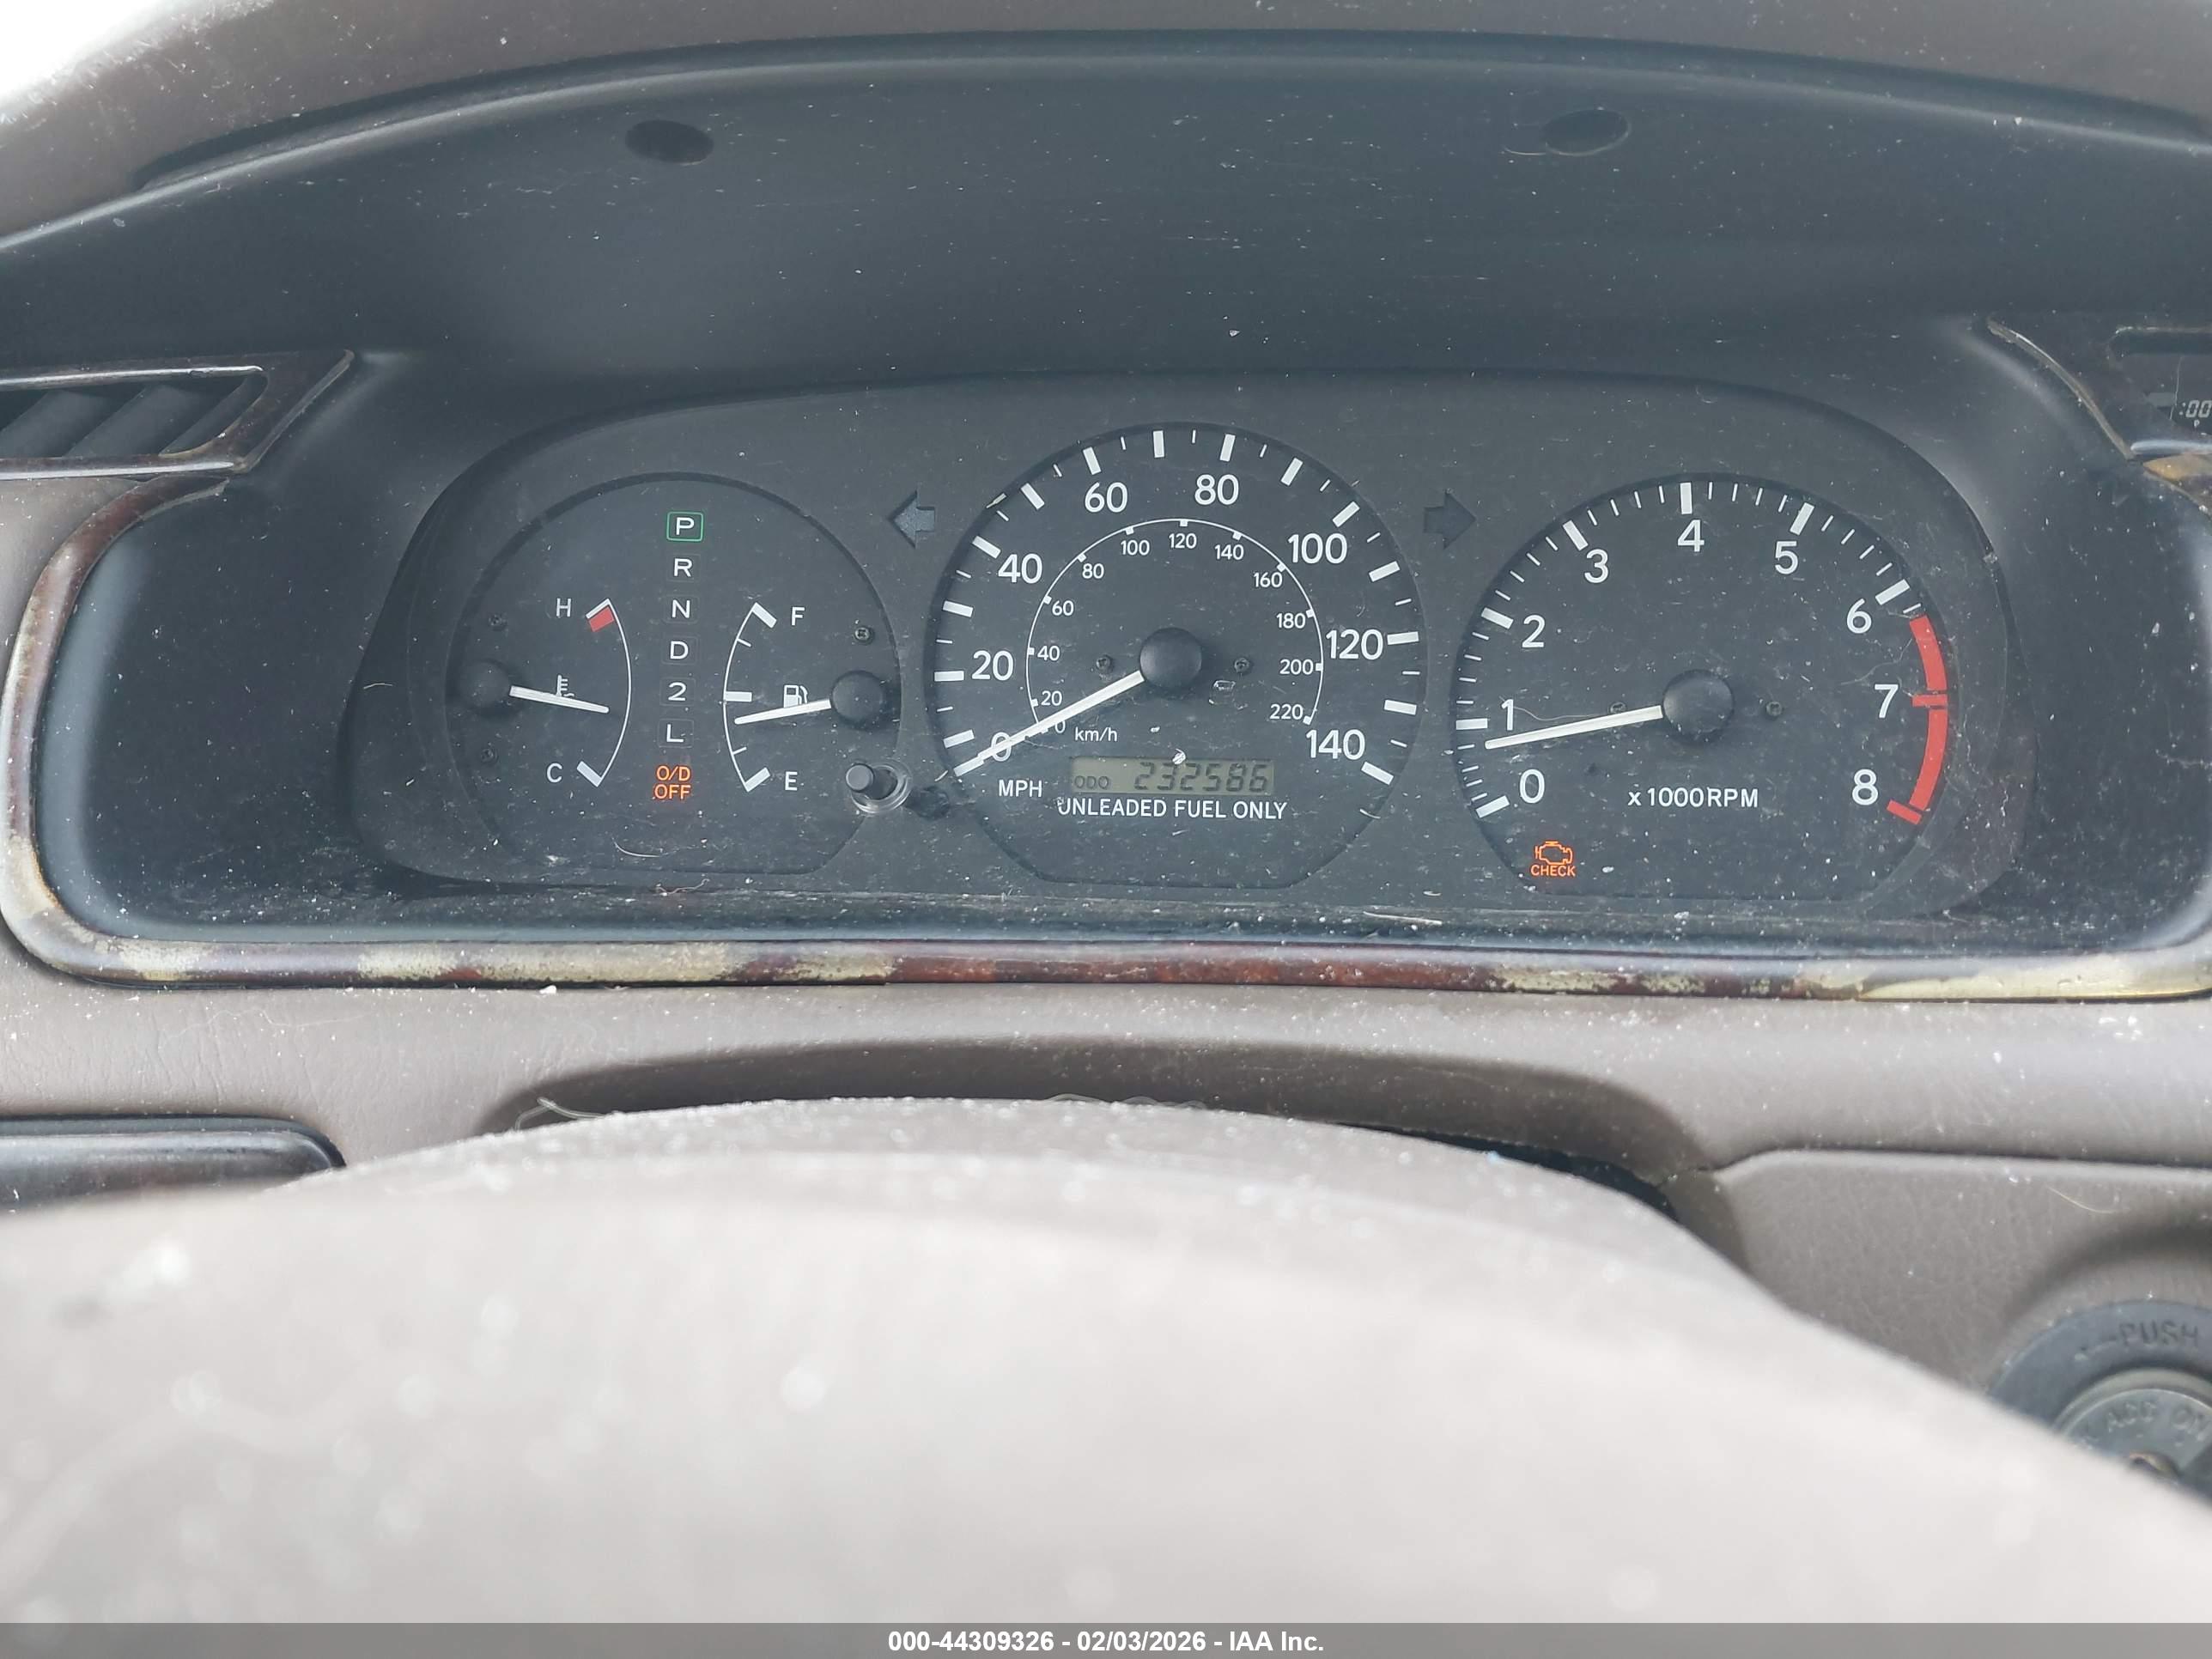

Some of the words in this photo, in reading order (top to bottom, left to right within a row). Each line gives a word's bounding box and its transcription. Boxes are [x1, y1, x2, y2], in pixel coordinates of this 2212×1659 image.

[1085, 482, 1128, 513] 60
[1194, 474, 1239, 506] 80
[676, 517, 695, 536] P
[1677, 519, 1705, 552] 4
[1121, 539, 1150, 556] 100
[1169, 532, 1197, 550] 120
[1287, 532, 1348, 564] 100
[1214, 544, 1244, 561] 140
[1774, 540, 1799, 574] 5
[673, 558, 693, 577] R
[998, 553, 1042, 584] 40
[1082, 562, 1105, 580] 80
[1584, 549, 1609, 584] 3
[1254, 571, 1283, 588] 160
[556, 598, 572, 617] H
[672, 599, 690, 618] N
[791, 606, 805, 626] F
[1052, 599, 1074, 617] 60
[1846, 598, 1872, 634] 6
[1276, 612, 1306, 629] 180
[1522, 614, 1546, 648] 2
[670, 641, 689, 659] D
[1036, 645, 1060, 661] 40
[1326, 629, 1383, 660] 120
[971, 650, 1014, 681] 20
[1279, 659, 1314, 675] 200
[667, 682, 687, 702] 2
[1041, 690, 1063, 707] 20
[1874, 684, 1899, 719] 7
[1269, 703, 1304, 720] 220
[1501, 698, 1514, 731] 1
[666, 724, 684, 743] L
[1074, 726, 1118, 742] km/h
[1306, 729, 1365, 760] 140
[546, 763, 562, 783] C
[656, 765, 690, 781] O/D
[785, 771, 798, 791] E
[1073, 775, 1110, 790] ODO
[1133, 761, 1271, 793] 232586
[654, 783, 691, 799] OFF
[999, 779, 1042, 798] MPH
[1519, 769, 1545, 804] 0
[1851, 769, 1879, 805] 8
[1057, 795, 1168, 818] UNLEADED
[1175, 799, 1227, 818] FUEL
[1233, 800, 1288, 819] ONLY
[1530, 861, 1576, 878] CHECK
[2119, 1320, 2199, 1347] PUSH
